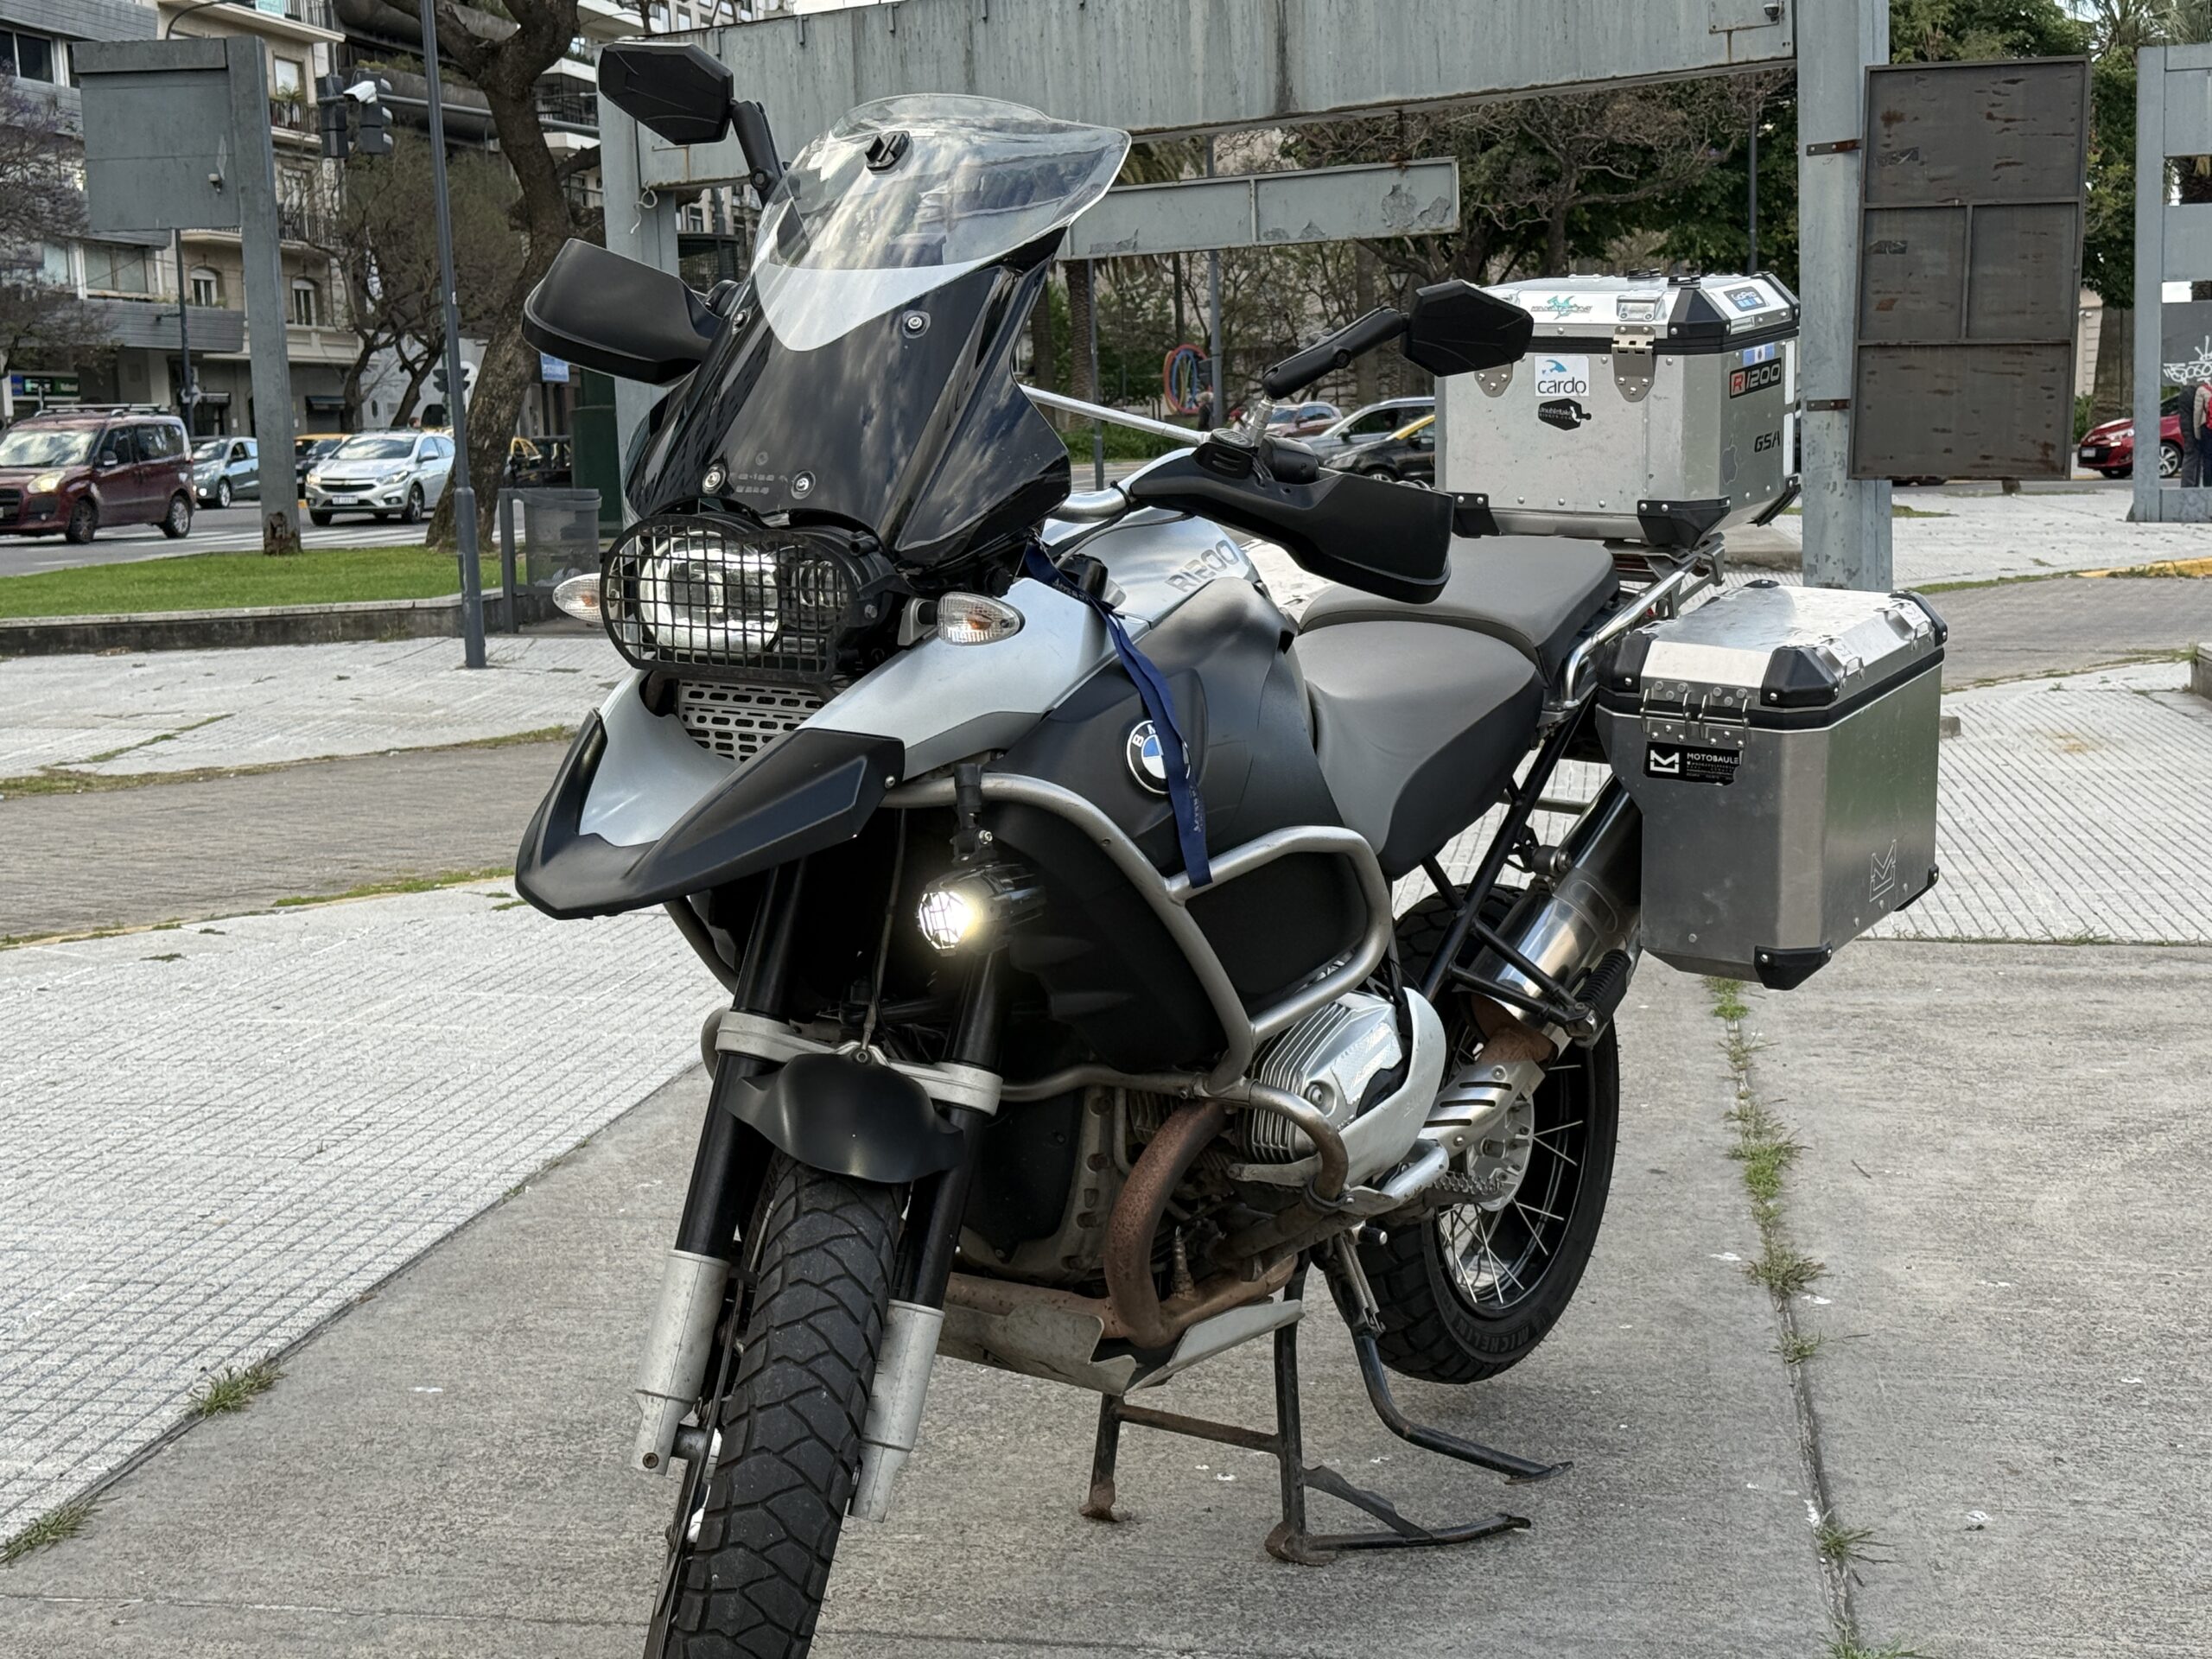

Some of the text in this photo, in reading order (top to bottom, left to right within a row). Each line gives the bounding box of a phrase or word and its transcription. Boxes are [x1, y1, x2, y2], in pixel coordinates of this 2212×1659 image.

[1731, 289, 1758, 301] GoPro
[1538, 377, 1586, 394] cardo
[1732, 364, 1781, 393] R1200
[1754, 430, 1781, 454] GSA
[1165, 539, 1239, 592] R1200
[1456, 1319, 1529, 1352] MICHELIN
